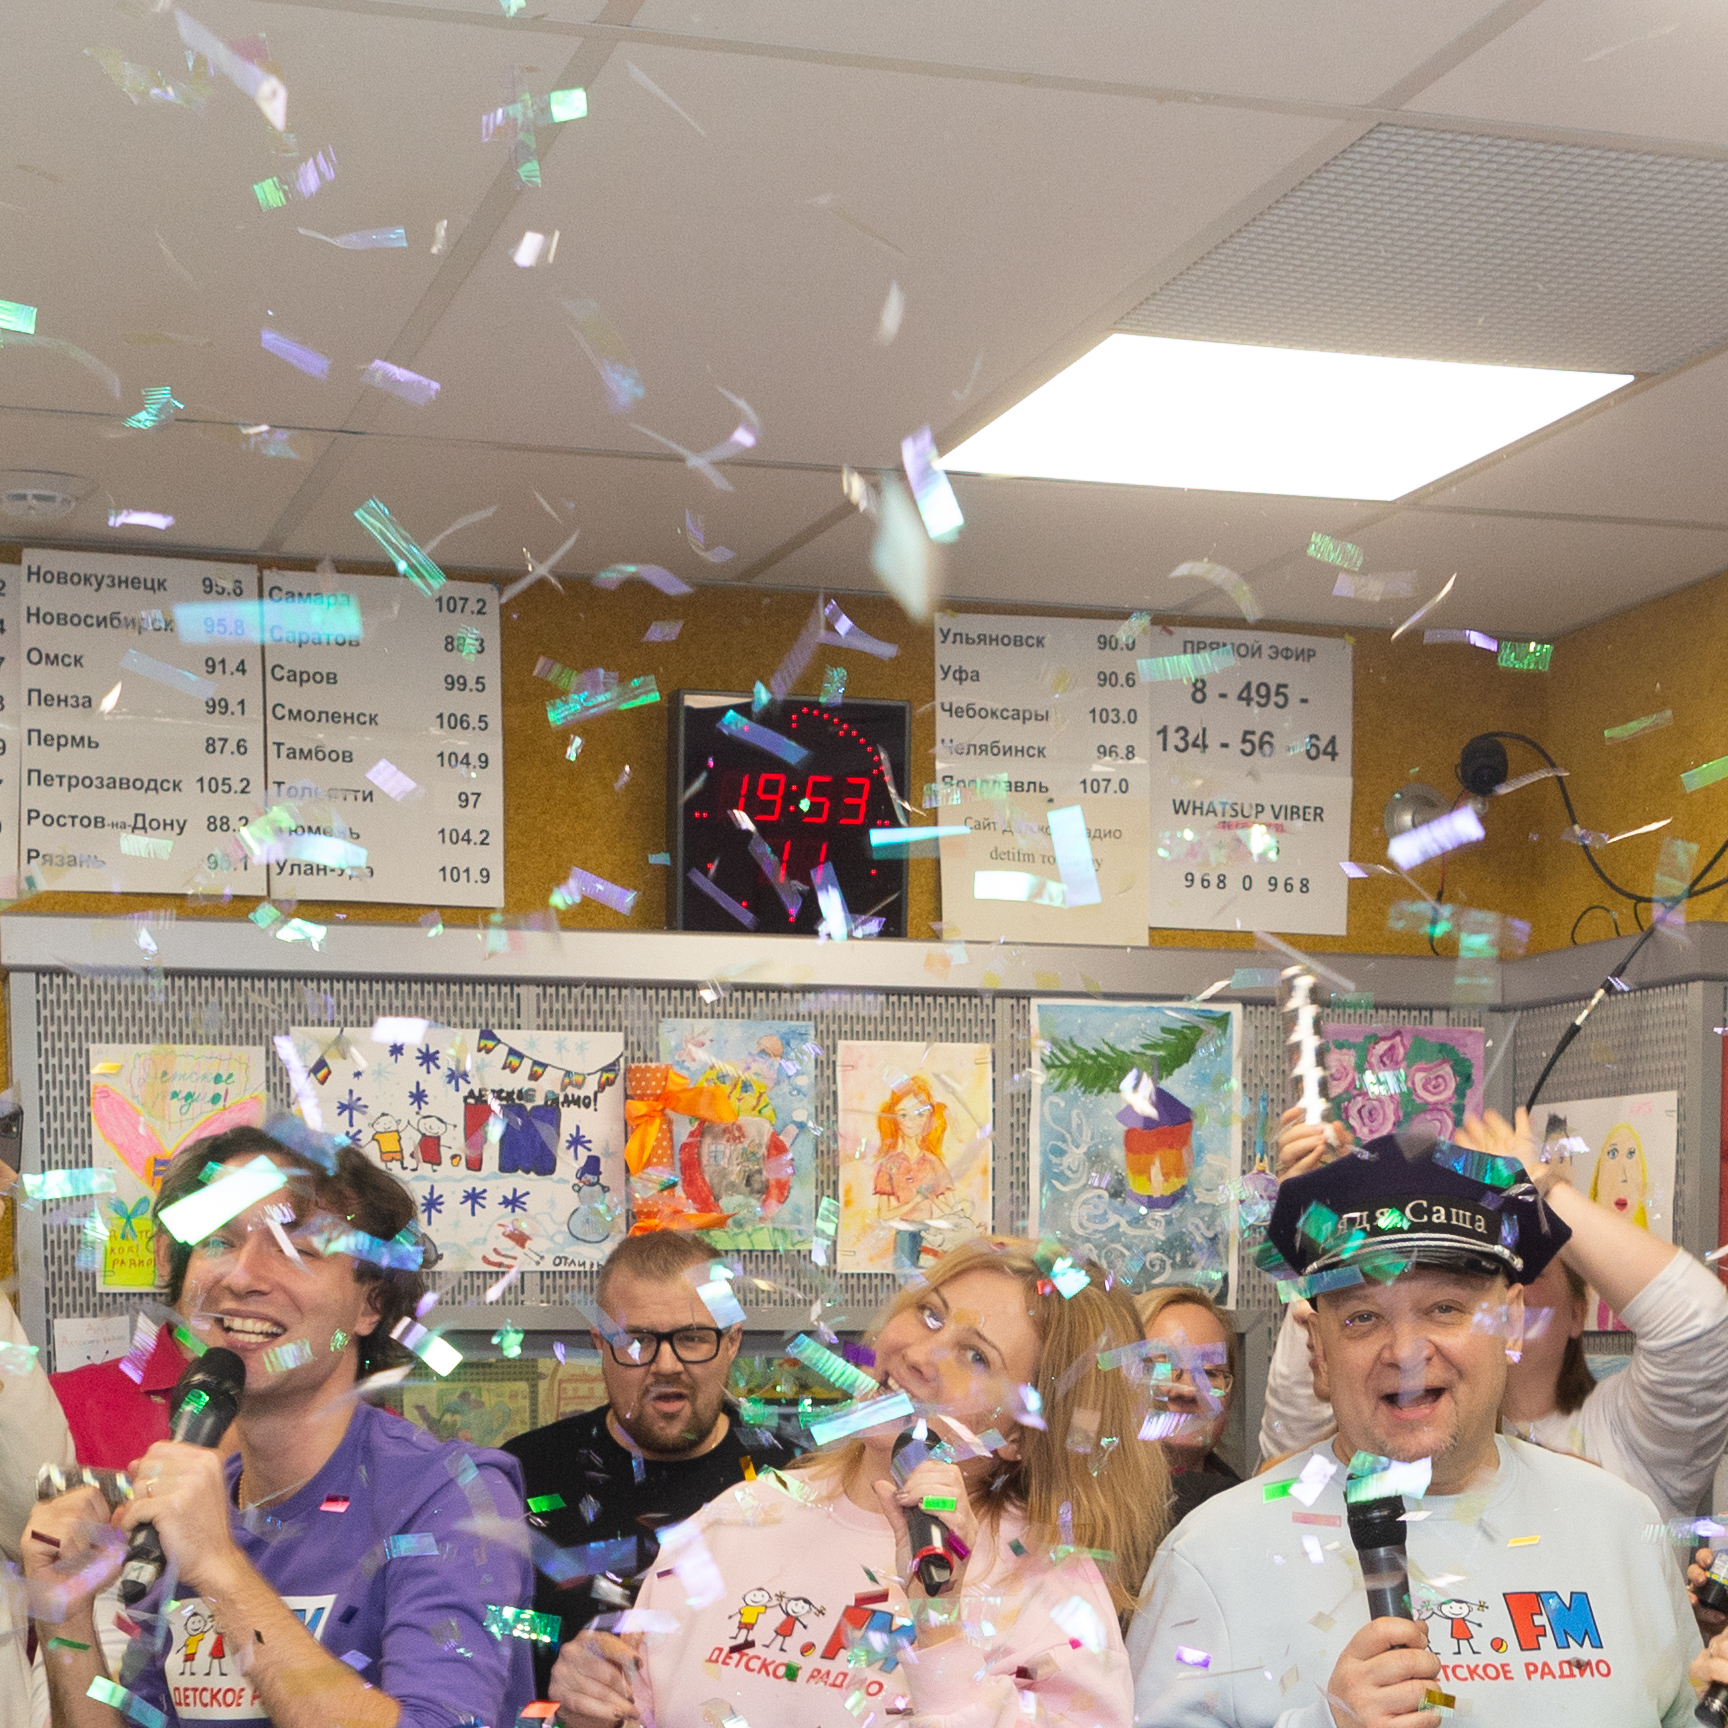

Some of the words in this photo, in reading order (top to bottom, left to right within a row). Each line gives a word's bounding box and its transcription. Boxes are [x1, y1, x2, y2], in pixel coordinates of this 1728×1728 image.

[26, 565, 168, 594] Новокузнецк
[269, 586, 350, 607] Самара
[435, 596, 487, 616] 107.2
[26, 606, 175, 635] Новосибирск
[270, 625, 360, 648] Саратов
[939, 627, 1046, 649] Ульяновск
[26, 647, 84, 668] Омск
[205, 657, 247, 677] 91.4
[1268, 644, 1317, 663] ЭФИР
[272, 664, 338, 687] Саров
[444, 674, 486, 693] 99.5
[939, 664, 980, 685] Уфа
[1096, 671, 1136, 688] 90.6
[27, 688, 92, 709] Пенза
[205, 698, 246, 716] 99.1
[1191, 678, 1207, 704] 8
[1237, 681, 1290, 709] 495
[272, 703, 379, 726] Смоленск
[436, 713, 489, 731] 106.5
[941, 701, 1049, 725] Чебоксары
[1088, 707, 1138, 725] 103.0
[27, 729, 100, 751] Пермь
[205, 737, 248, 756] 87.6
[272, 742, 354, 763] Тамбов
[437, 752, 489, 769] 104.9
[940, 737, 1047, 759] Челябинск
[1096, 744, 1136, 761] 96.8
[1156, 725, 1209, 754] 134
[1240, 730, 1275, 758] 56
[1305, 733, 1339, 762] 64
[27, 769, 183, 794] Петрозаводск
[196, 776, 251, 795] 105.2
[1080, 778, 1130, 795] 107.0
[458, 792, 482, 809] 97
[737, 773, 871, 825] 19:53
[1172, 798, 1265, 820] WHATSUP
[1270, 803, 1325, 823] VIBER
[27, 809, 188, 836] Ростов-на-Дону
[277, 822, 360, 840] юмеь
[438, 828, 490, 846] 104.2
[964, 816, 997, 832] Сайт
[1086, 826, 1123, 841] адио
[27, 848, 106, 868] Рязань
[207, 854, 248, 872] 9.1
[779, 840, 828, 884] 11
[439, 866, 490, 884] 101.9
[1405, 1200, 1488, 1234] Саша
[1502, 1591, 1604, 1652] FM
[705, 1645, 801, 1682] ДЕТСКО
[1435, 1661, 1514, 1683] ТСКОЕ
[1525, 1658, 1612, 1681] РАДИО
[173, 1686, 246, 1708] ДЕТСКОЕ
